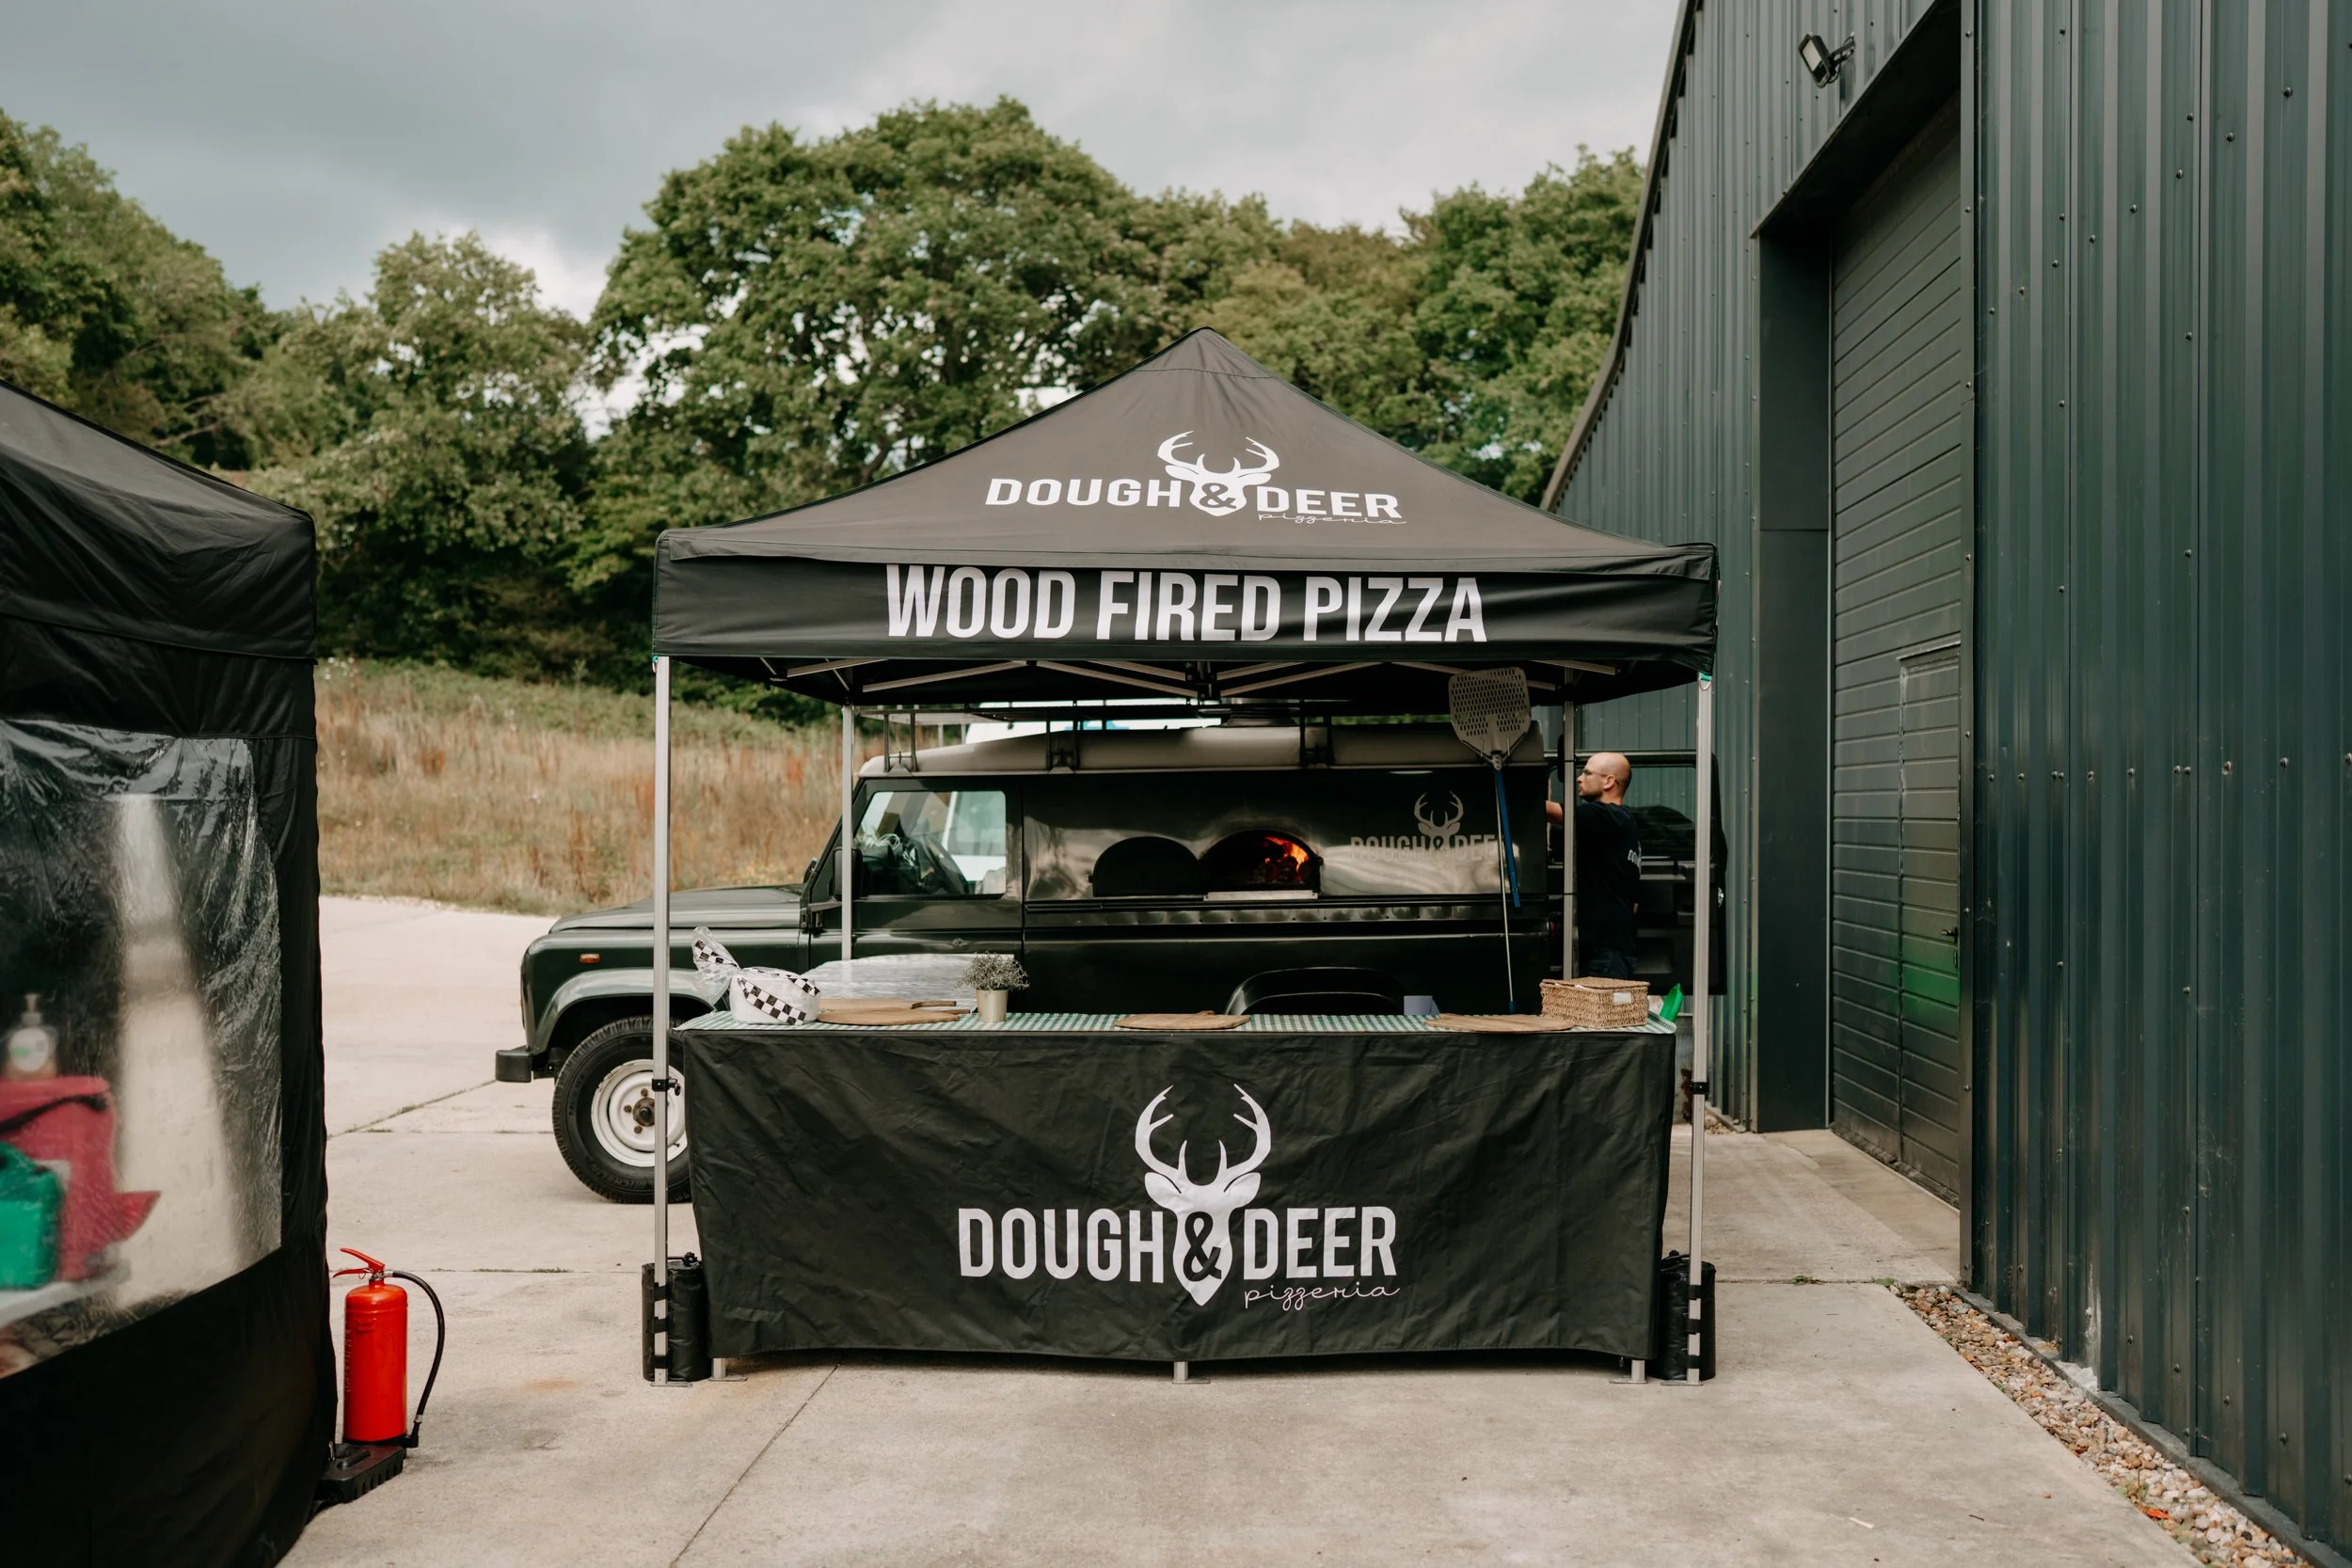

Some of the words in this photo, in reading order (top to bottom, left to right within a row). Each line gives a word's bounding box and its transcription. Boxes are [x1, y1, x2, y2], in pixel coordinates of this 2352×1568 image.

[985, 478, 1182, 508] DOUGH
[1199, 483, 1236, 509] &
[1256, 486, 1402, 519] DEER
[1258, 513, 1407, 525] pizzeria
[886, 564, 1075, 639] WOOD
[1096, 572, 1281, 641] FIRED
[1303, 577, 1487, 642] PIZZA
[1350, 835, 1426, 863] DOUGH
[1454, 833, 1504, 862] DEE
[958, 1207, 1164, 1284] DOUGH
[1183, 1211, 1222, 1282] &
[1243, 1206, 1397, 1280] DEER
[1244, 1281, 1401, 1311] pizzeria
